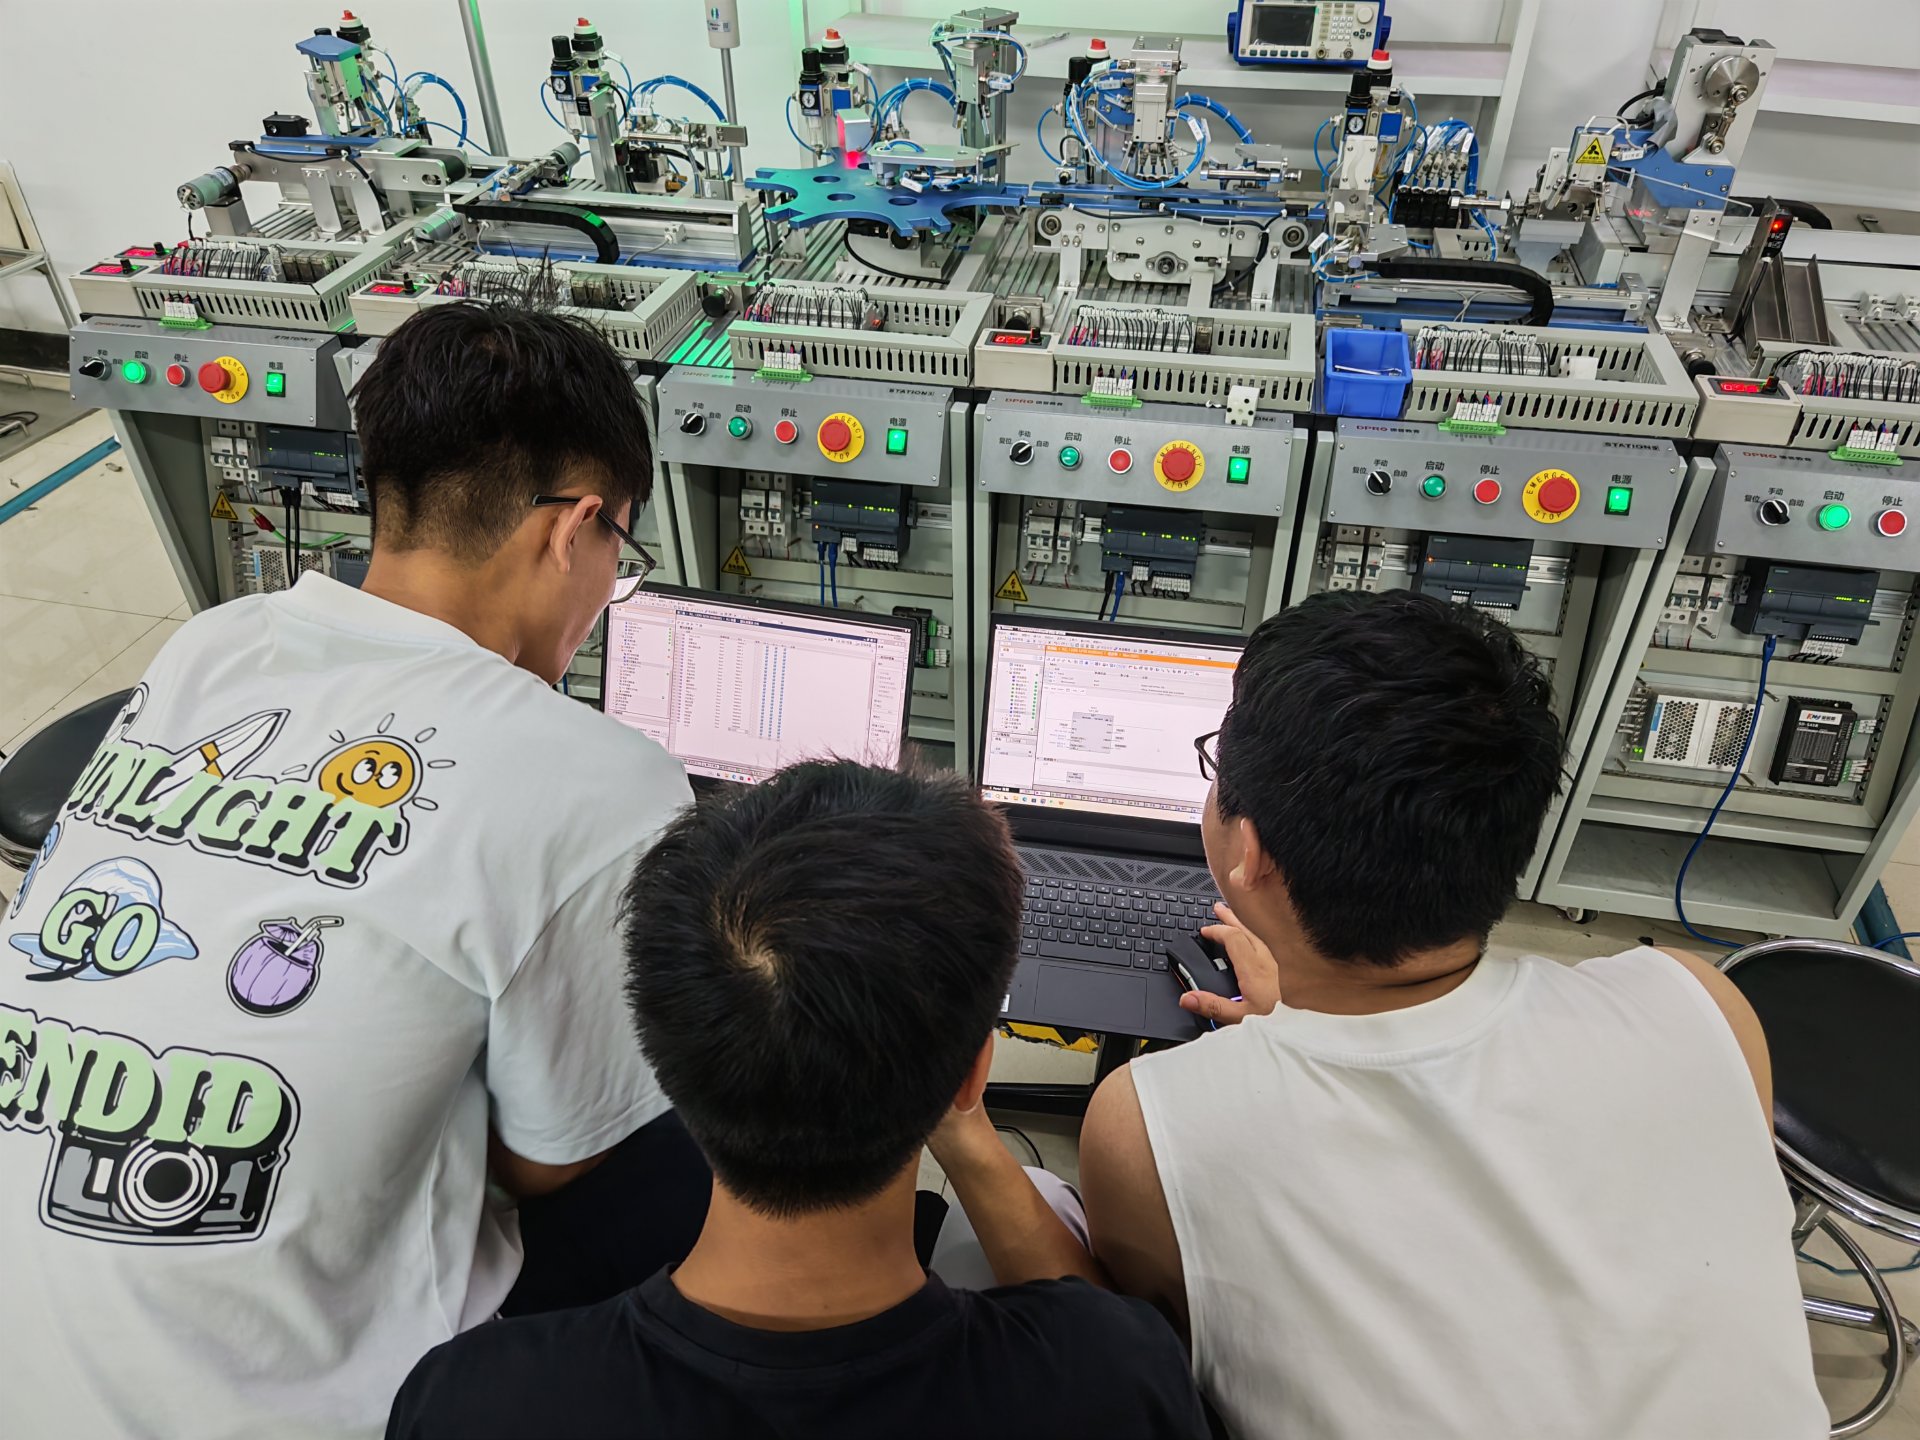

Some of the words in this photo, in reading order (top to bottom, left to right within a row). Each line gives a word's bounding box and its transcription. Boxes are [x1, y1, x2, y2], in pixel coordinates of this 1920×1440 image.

[174, 353, 189, 362] 停止
[735, 404, 752, 413] 启动
[781, 408, 798, 418] 停止
[890, 417, 907, 427] 电源
[1018, 430, 1031, 438] 手动
[1064, 432, 1082, 442] 启动
[999, 437, 1012, 445] 复位
[1036, 440, 1049, 448] 自动
[1114, 435, 1132, 446] 停止
[1232, 444, 1251, 455] 电源
[827, 450, 850, 460] STOP
[1742, 451, 1778, 459] DPRO
[1373, 459, 1388, 467] 手动
[1425, 460, 1445, 471] 启动
[1352, 466, 1367, 474] 复位
[1393, 469, 1408, 477] 自动
[1480, 464, 1500, 475] 停止
[1164, 479, 1189, 489] STOP
[1611, 474, 1632, 485] 电源
[1768, 487, 1784, 496] 手动
[1823, 490, 1845, 501] 启动
[1744, 494, 1761, 503] 复位
[1789, 498, 1805, 507] 自动
[1882, 495, 1904, 507] 停止
[1534, 510, 1562, 520] STOP
[39, 888, 161, 977] GO
[0, 1011, 293, 1149] ENDID
